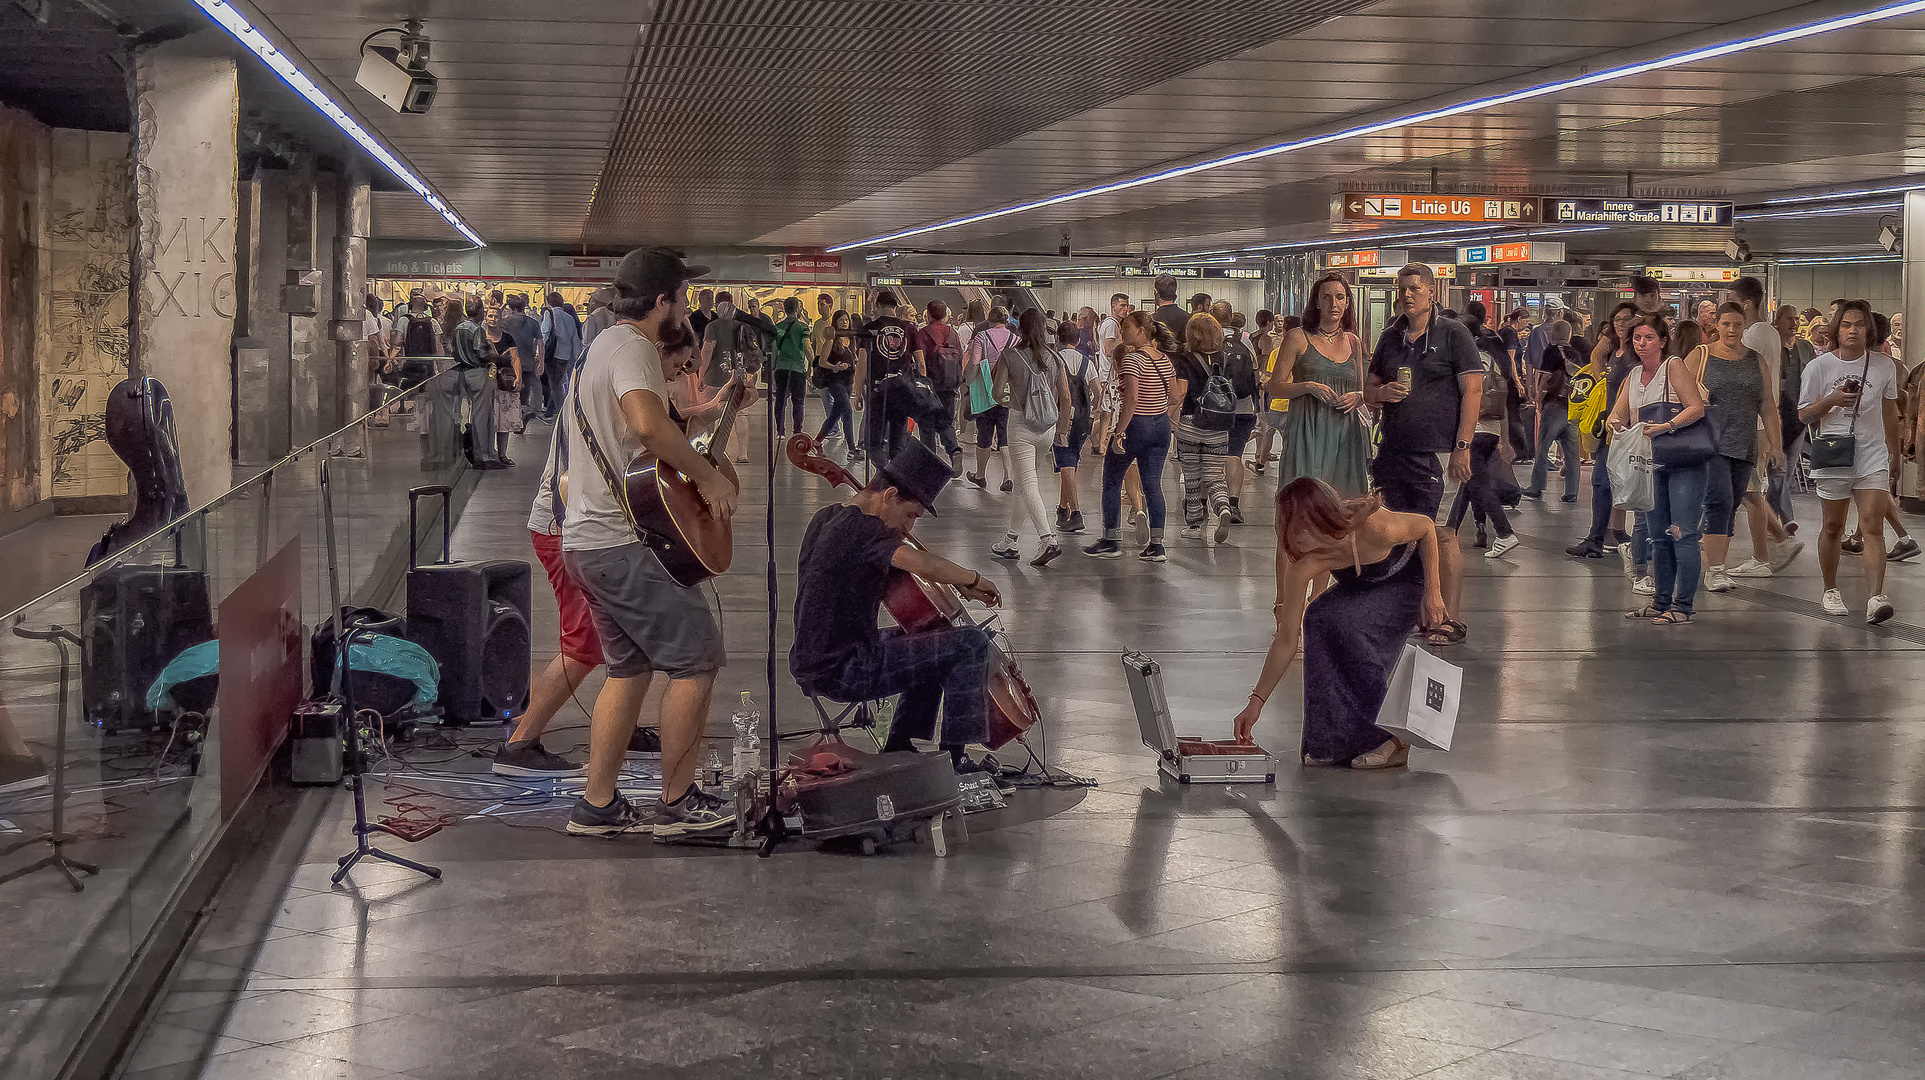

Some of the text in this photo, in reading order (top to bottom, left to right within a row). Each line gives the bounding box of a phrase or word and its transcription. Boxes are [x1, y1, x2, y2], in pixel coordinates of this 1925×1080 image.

[1412, 199, 1471, 215] Linie U6
[1603, 201, 1633, 211] Innere
[1577, 211, 1660, 222] Mariahilfer Straße
[387, 262, 462, 274] Info & Tickets
